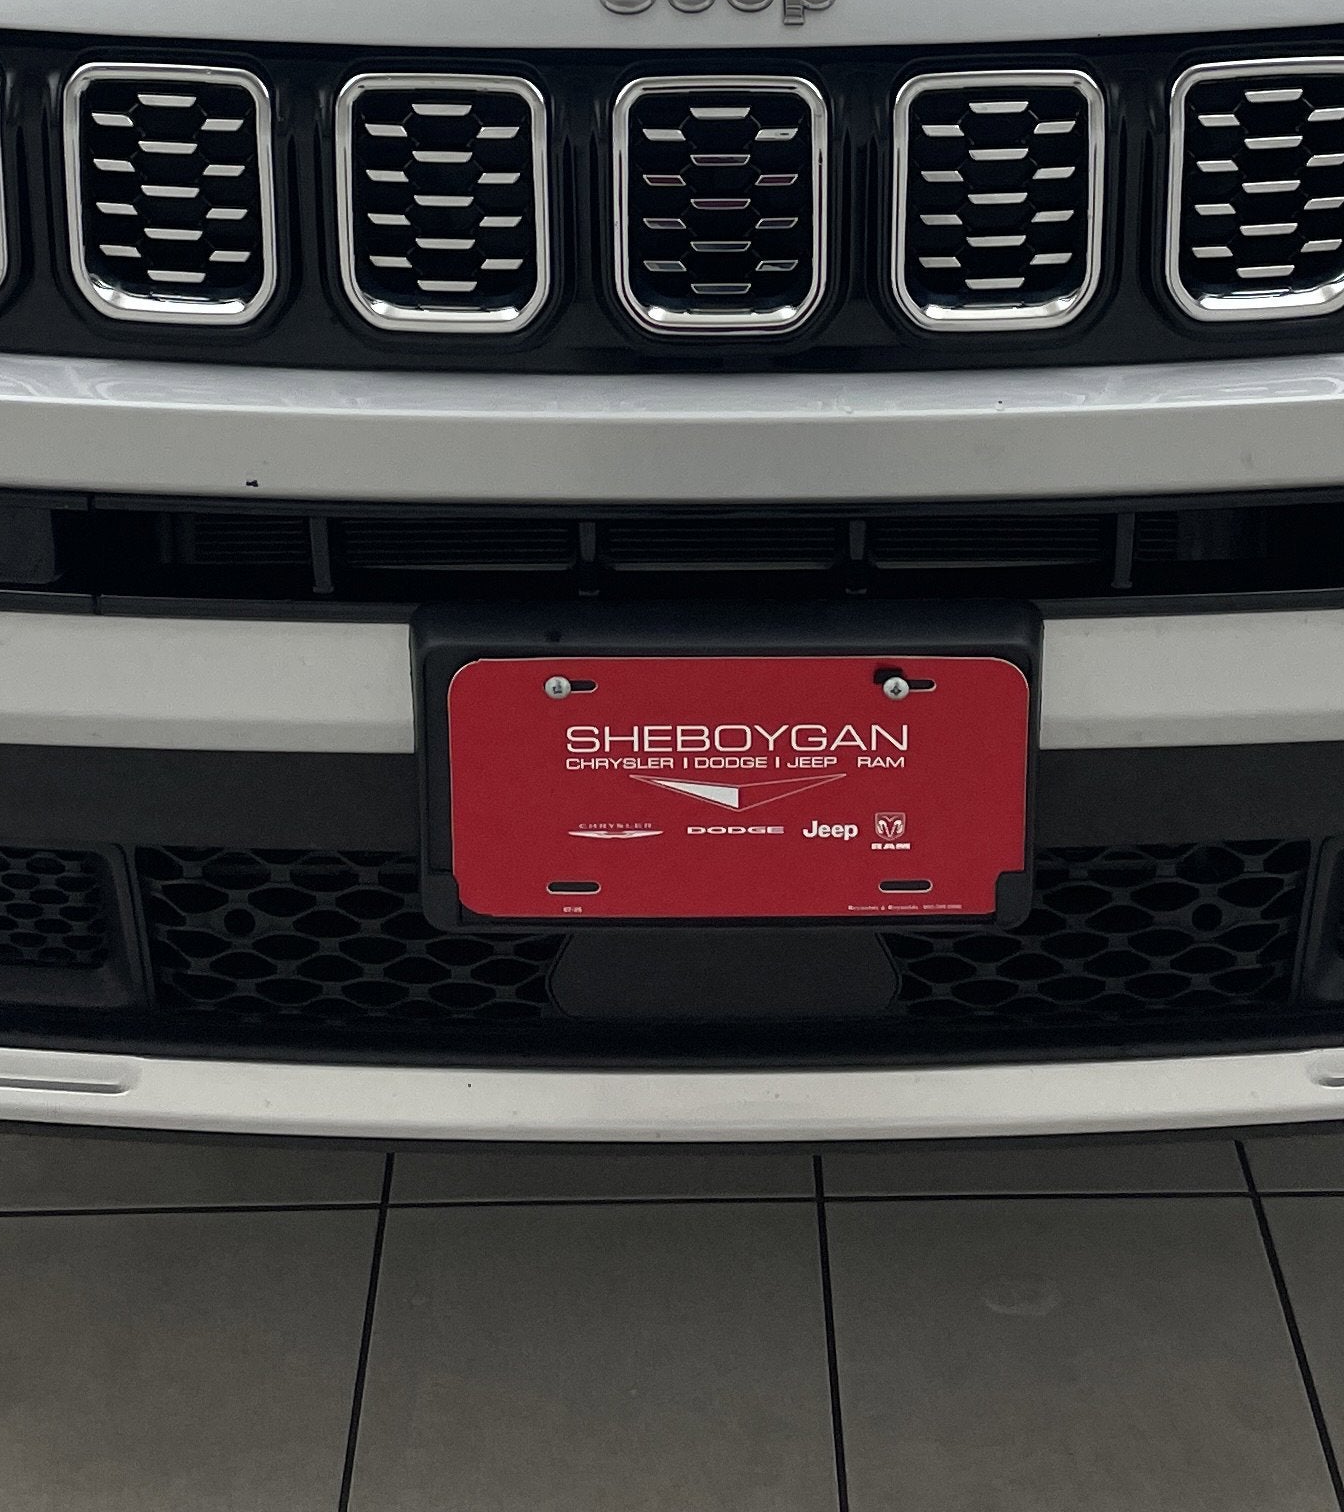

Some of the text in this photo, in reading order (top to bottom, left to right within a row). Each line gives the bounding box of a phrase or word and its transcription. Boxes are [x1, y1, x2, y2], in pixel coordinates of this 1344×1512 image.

[565, 724, 909, 753] SHEBOYGAN
[565, 756, 906, 770] CHRYSLER DODGE JEEP RAM
[687, 826, 785, 835] DODGE
[802, 820, 859, 841] Jeep
[871, 842, 911, 850] RAM
